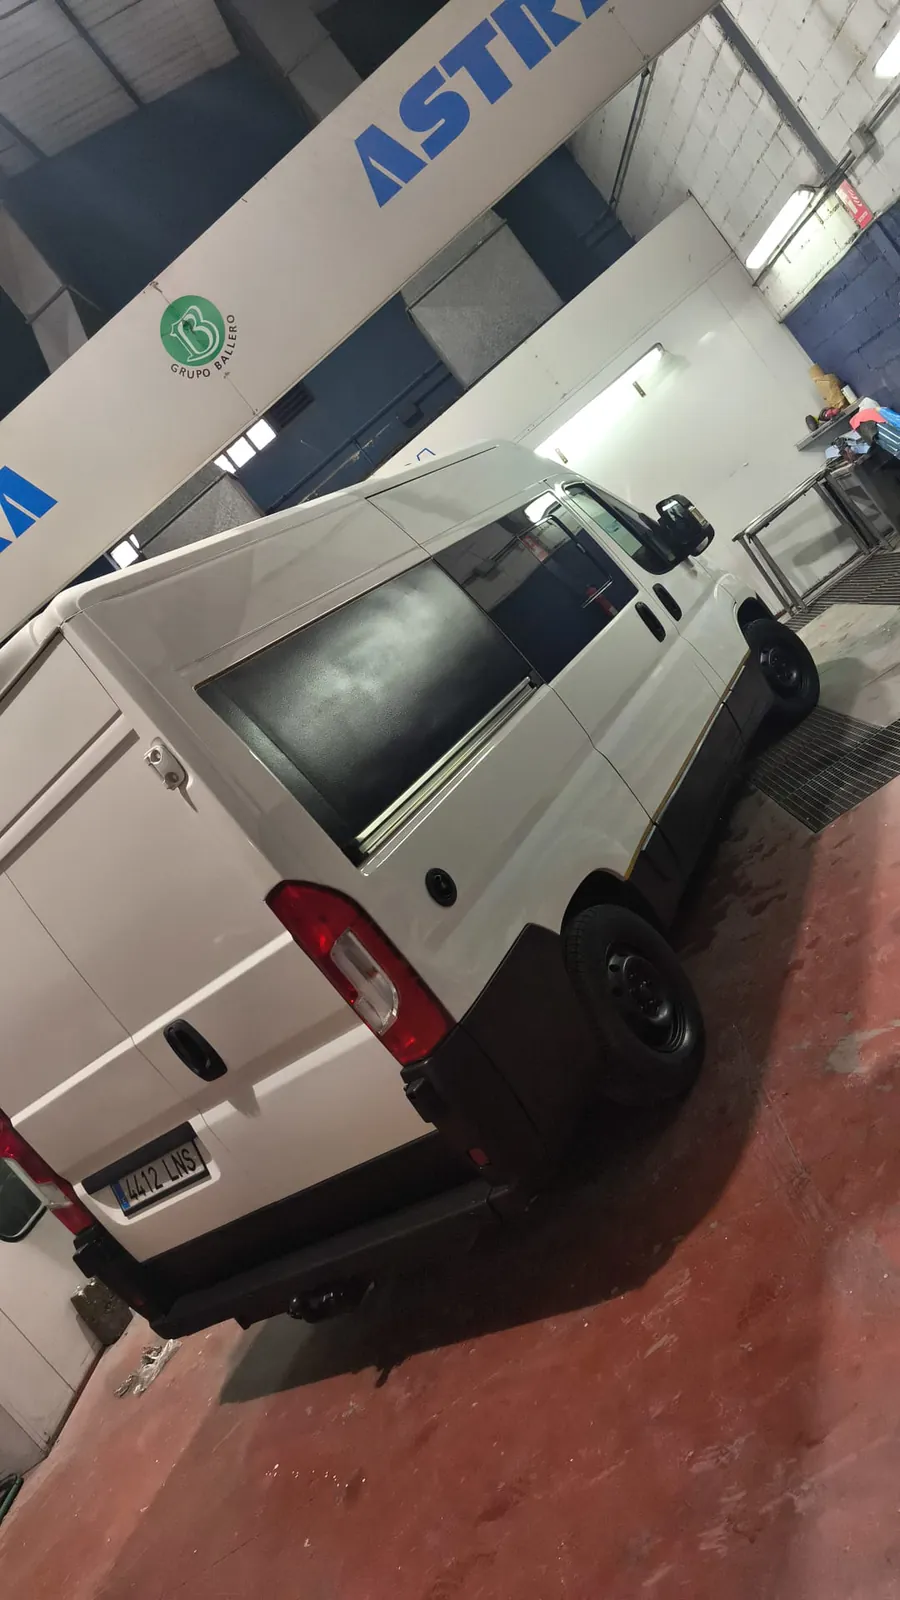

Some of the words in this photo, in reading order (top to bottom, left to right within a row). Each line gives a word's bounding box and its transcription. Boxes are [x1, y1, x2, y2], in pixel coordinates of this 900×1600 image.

[354, 0, 608, 208] ASTR
[170, 363, 211, 379] GRUPO
[214, 314, 238, 371] BALLERO
[125, 1166, 164, 1201] 4412
[161, 1148, 197, 1182] LNS
